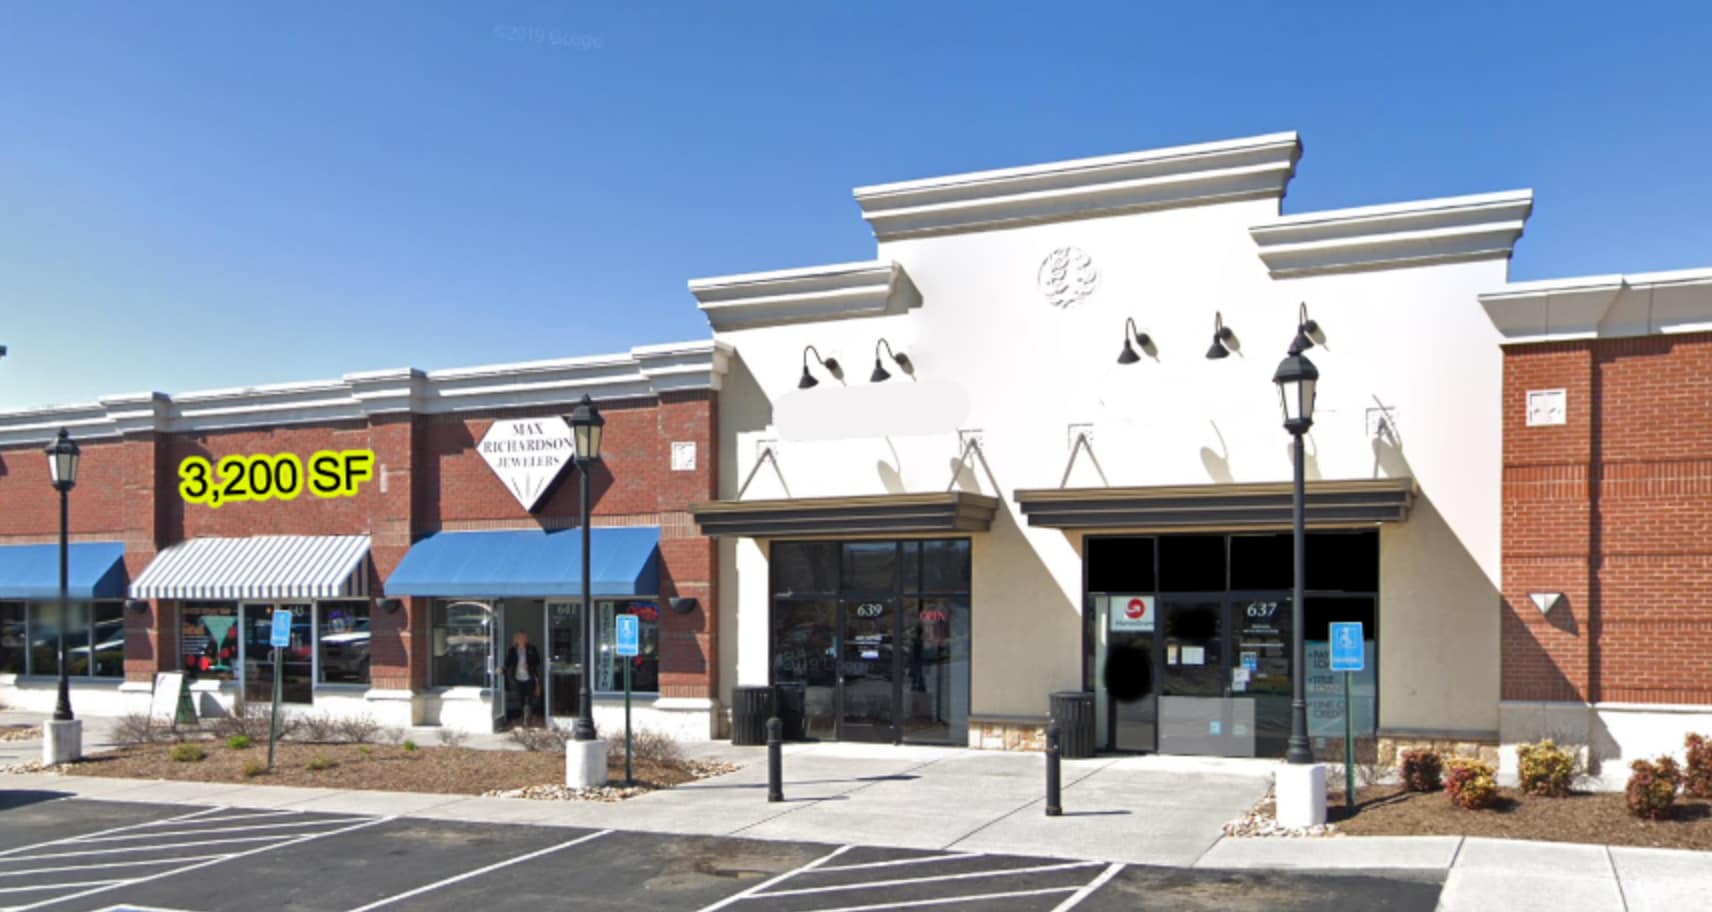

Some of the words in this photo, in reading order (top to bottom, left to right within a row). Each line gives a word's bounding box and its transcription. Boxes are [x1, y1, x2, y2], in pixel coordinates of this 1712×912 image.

[512, 423, 544, 435] MAX
[483, 437, 573, 453] RICHARDSON
[497, 455, 561, 468] JEWELERS
[857, 603, 883, 617] 639
[1247, 601, 1278, 616] 637
